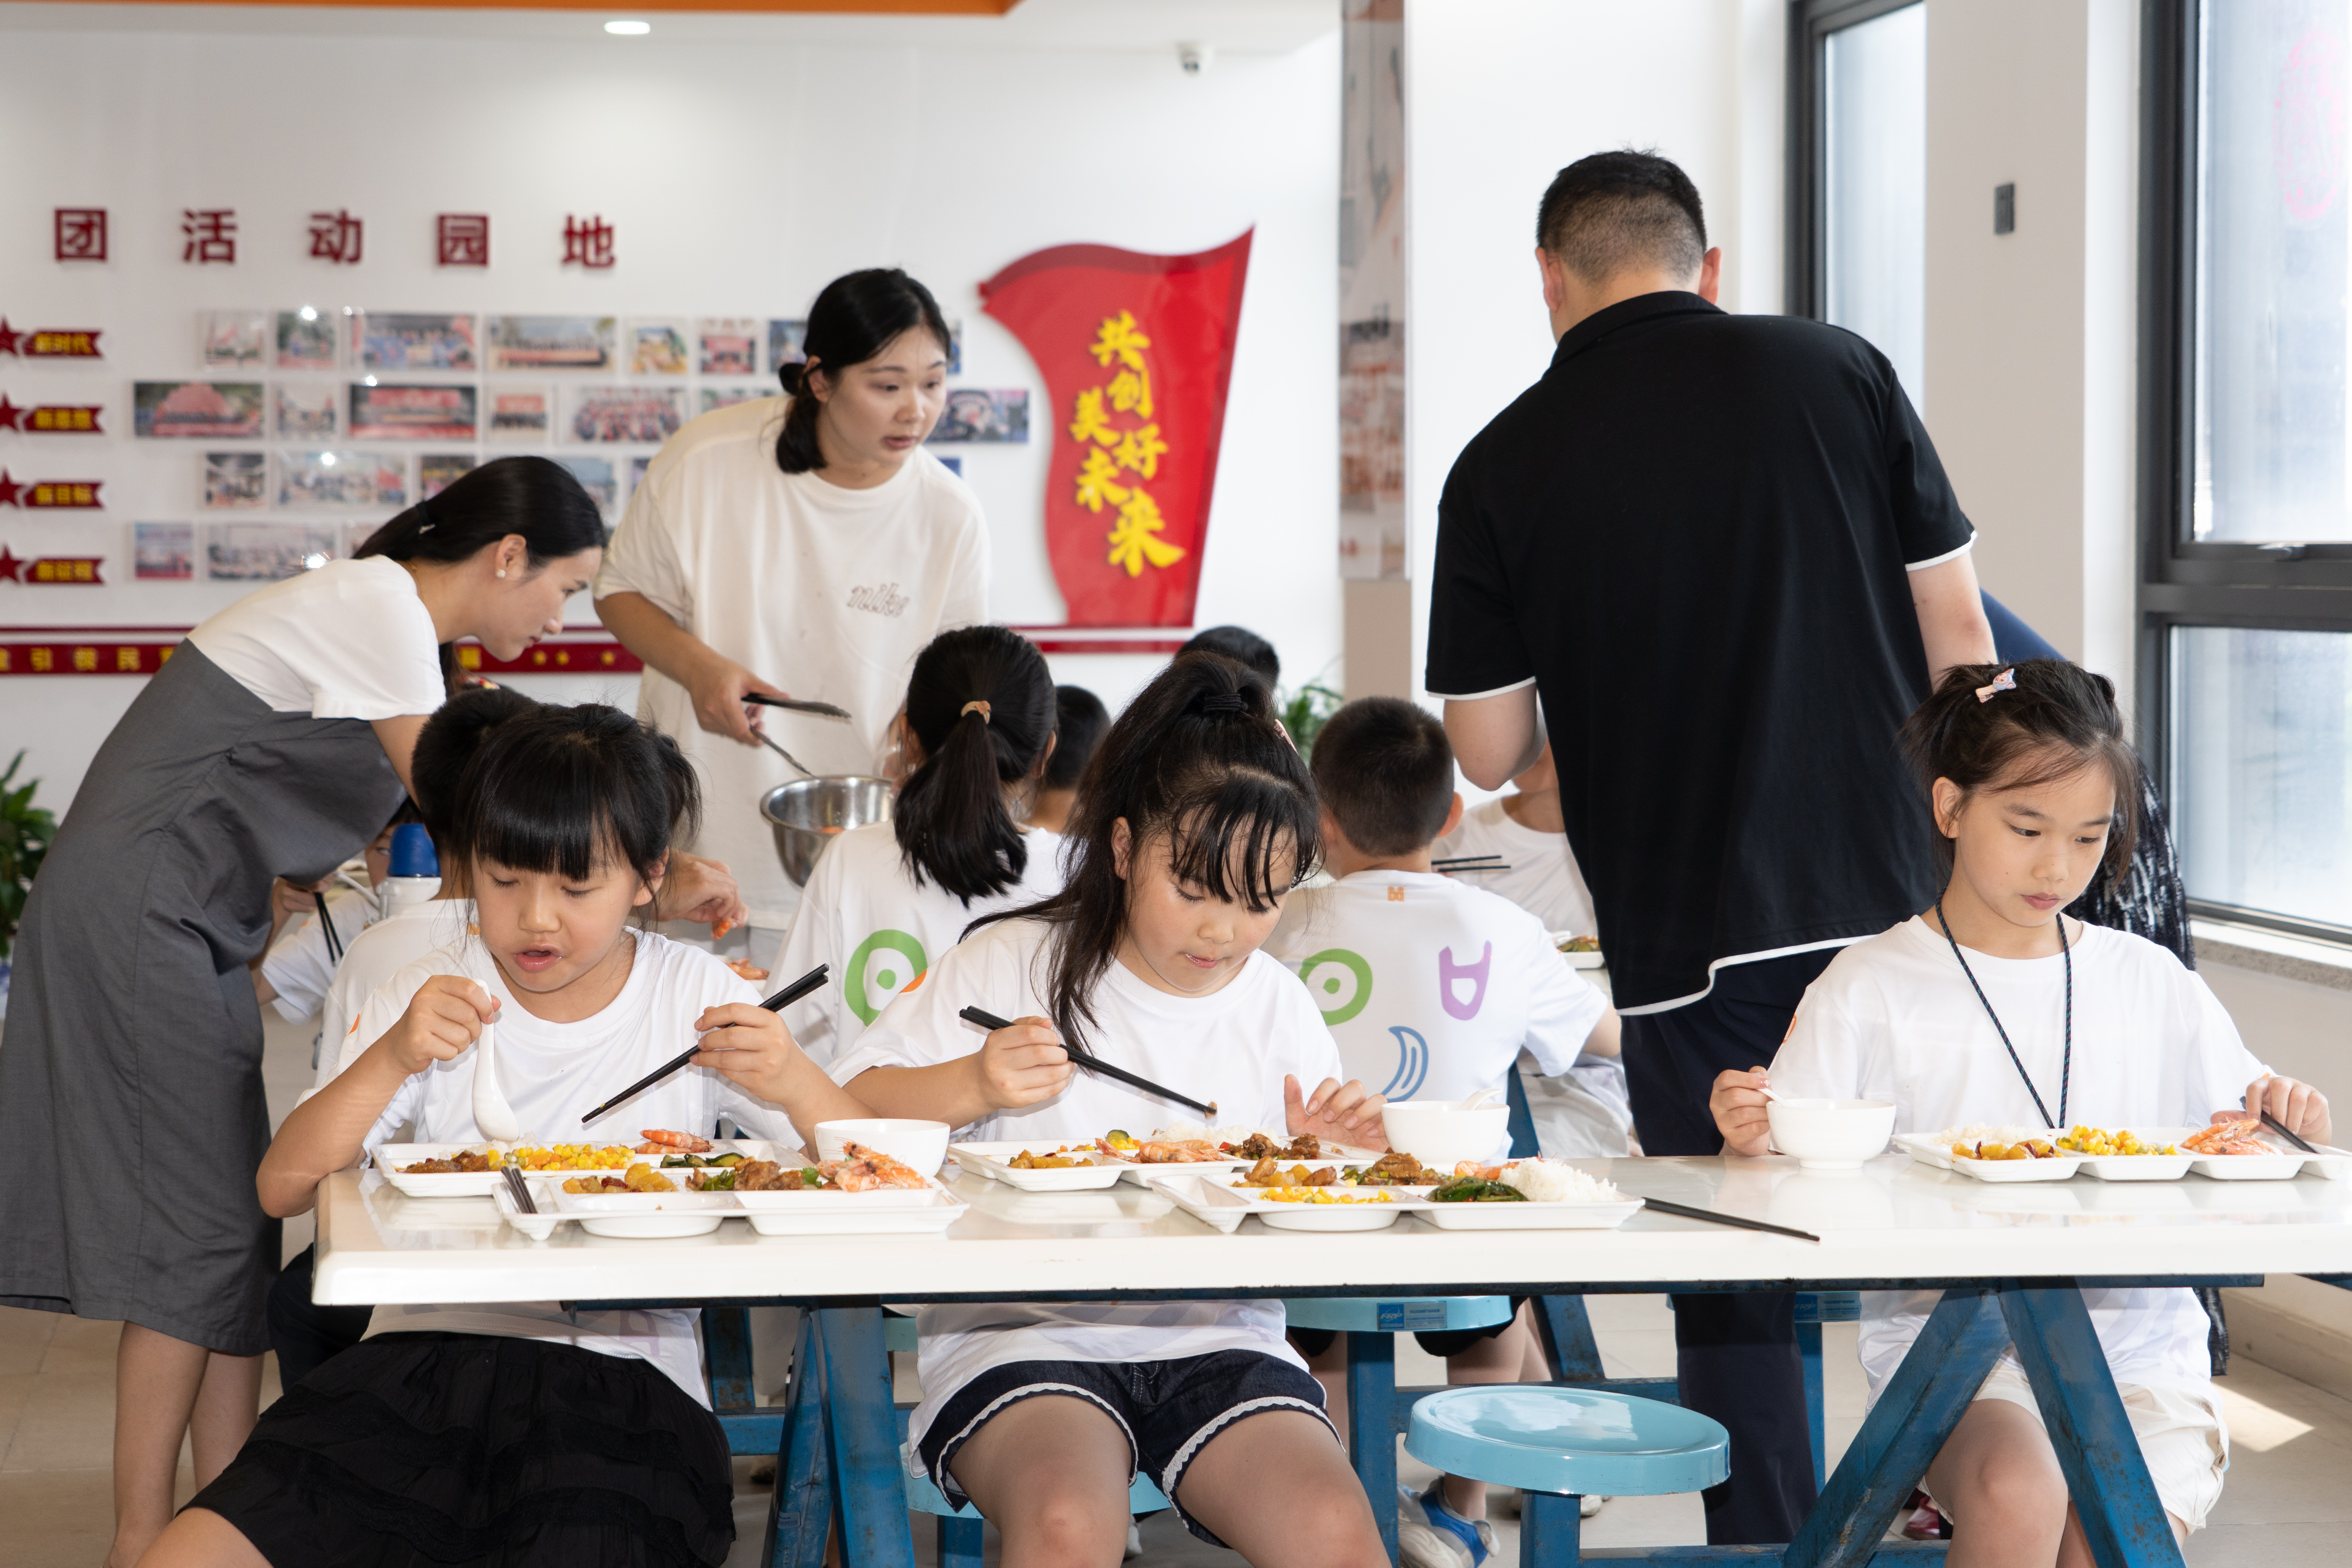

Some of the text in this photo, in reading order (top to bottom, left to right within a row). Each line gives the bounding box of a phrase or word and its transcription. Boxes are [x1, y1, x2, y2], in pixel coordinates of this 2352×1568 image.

[54, 207, 616, 268] 团活动园地
